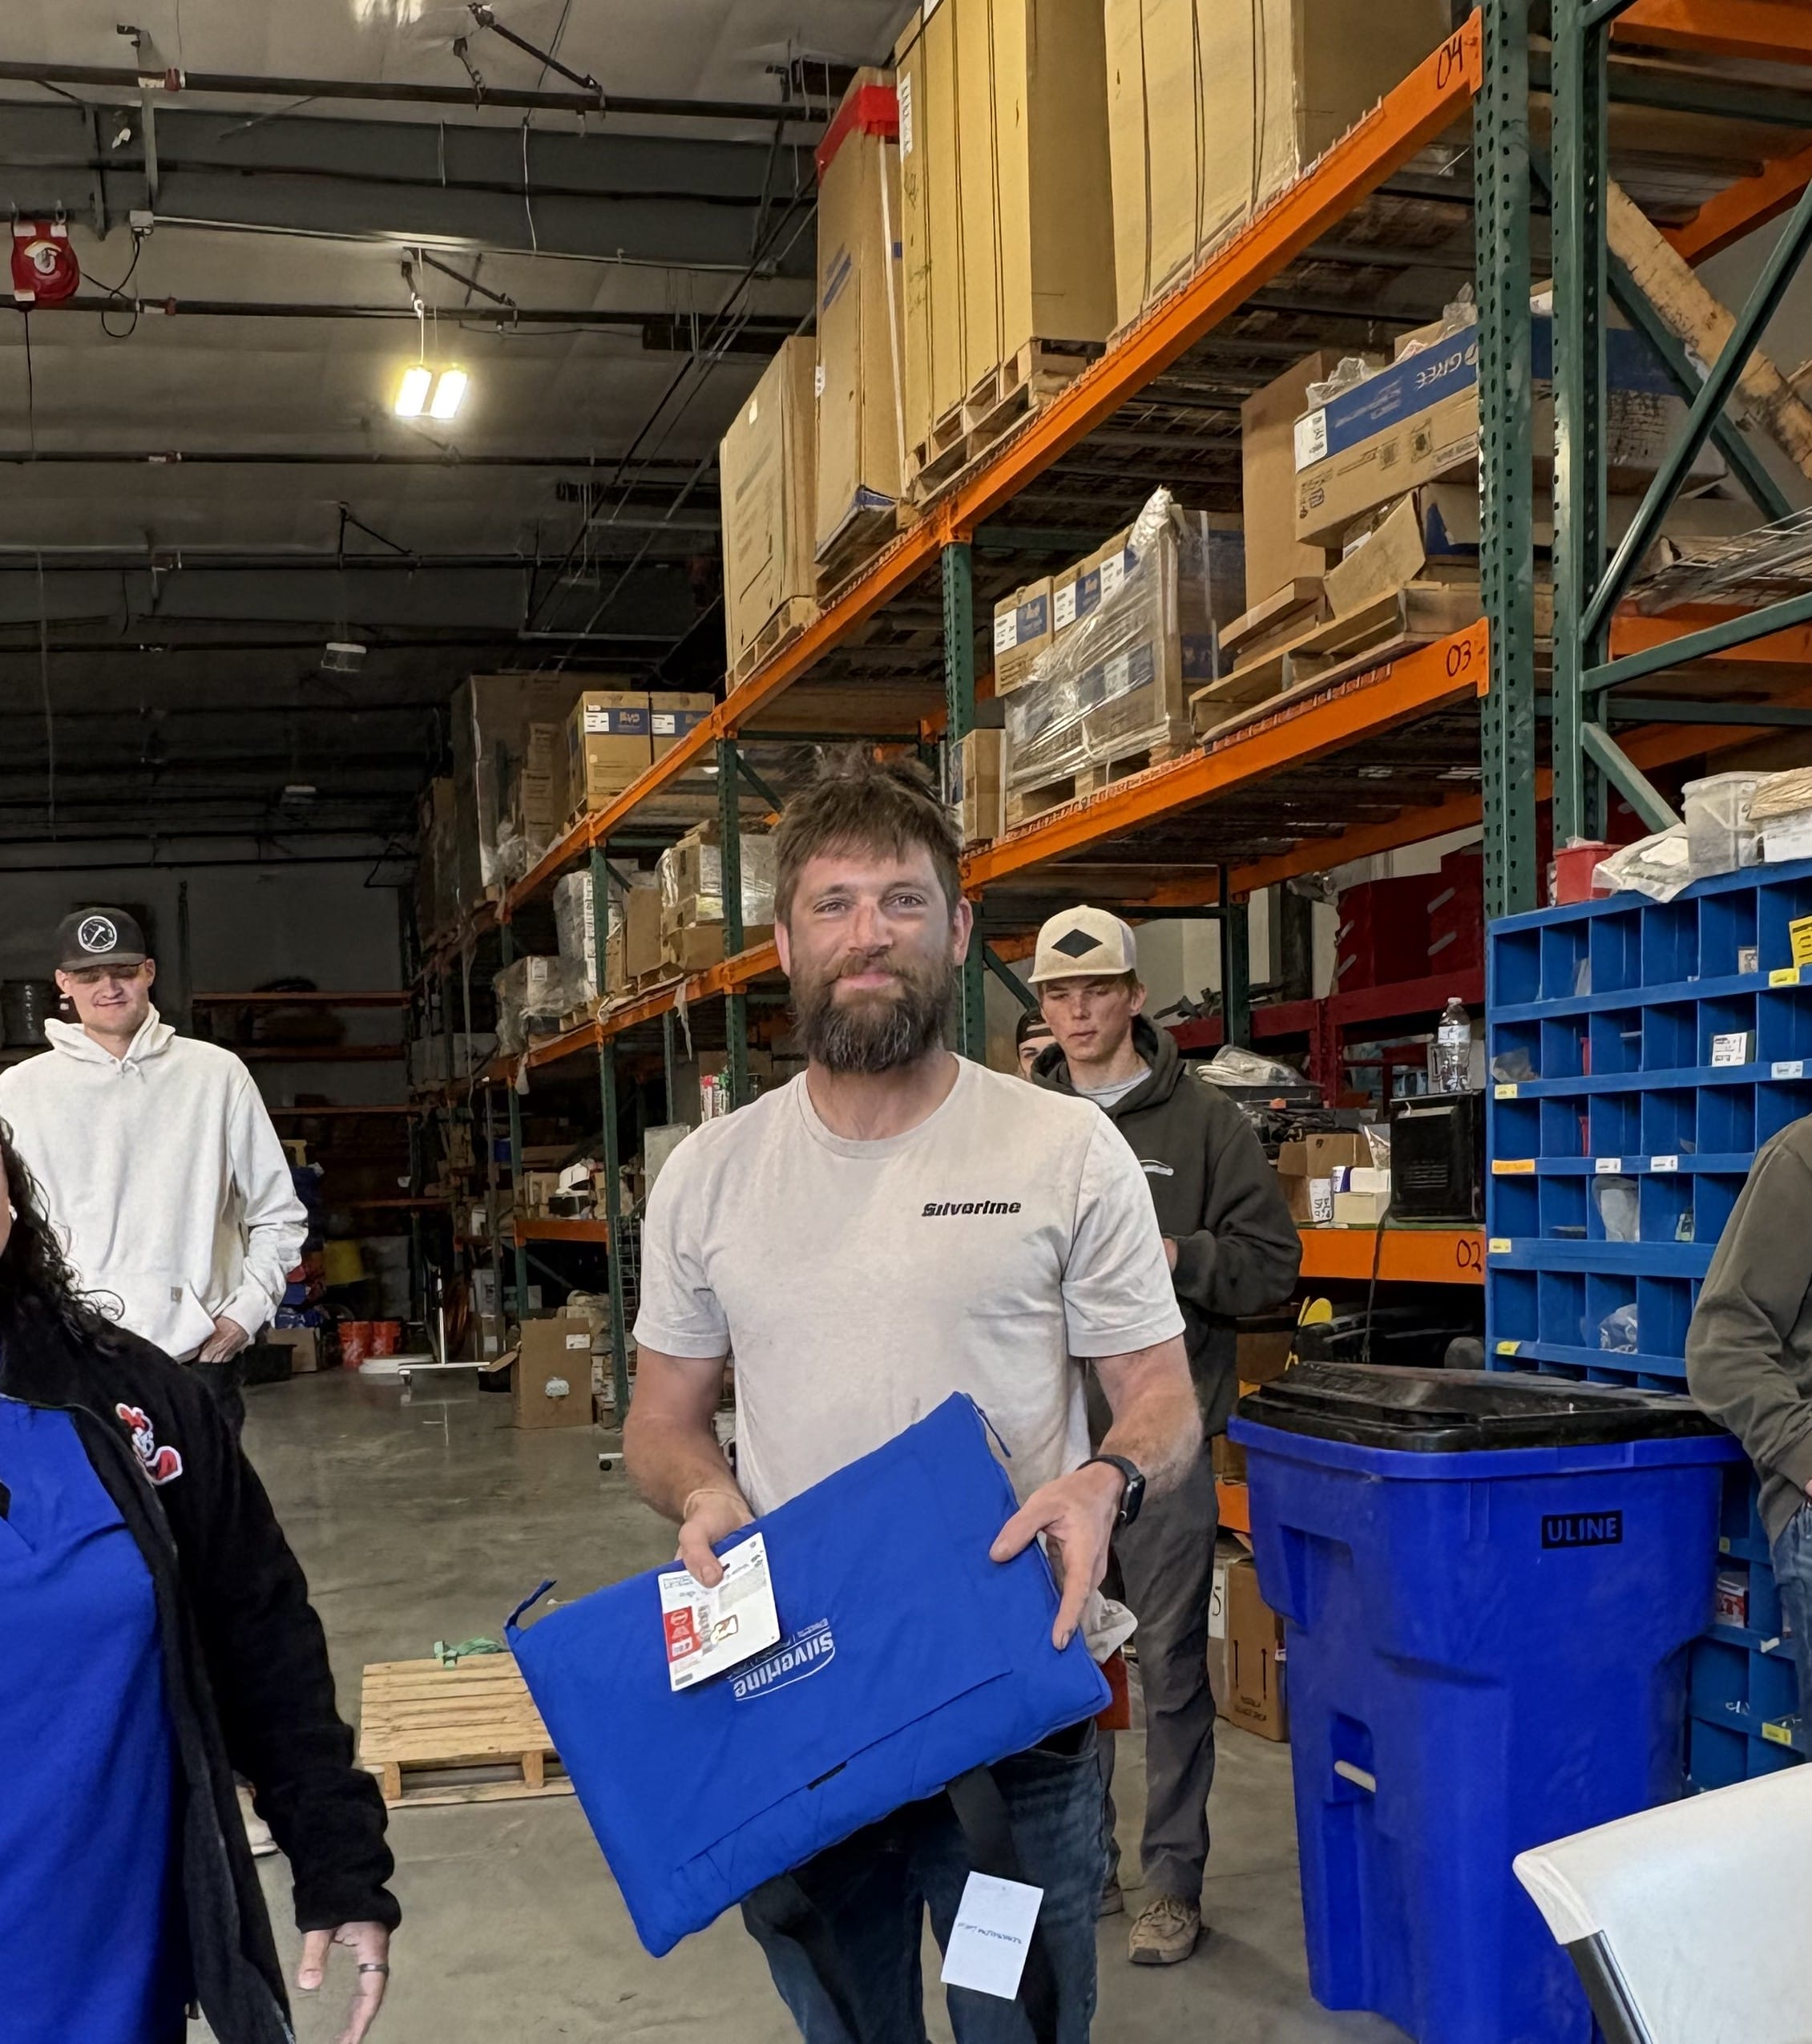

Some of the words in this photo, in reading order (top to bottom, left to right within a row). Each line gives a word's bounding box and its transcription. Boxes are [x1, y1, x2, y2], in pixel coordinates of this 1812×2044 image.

[1436, 35, 1463, 90] 04
[1446, 640, 1472, 677] 03
[922, 1200, 1021, 1217] Silverline
[1456, 1239, 1482, 1271] 02
[1547, 1517, 1617, 1541] ULINE
[732, 1630, 834, 1699] Silverline
